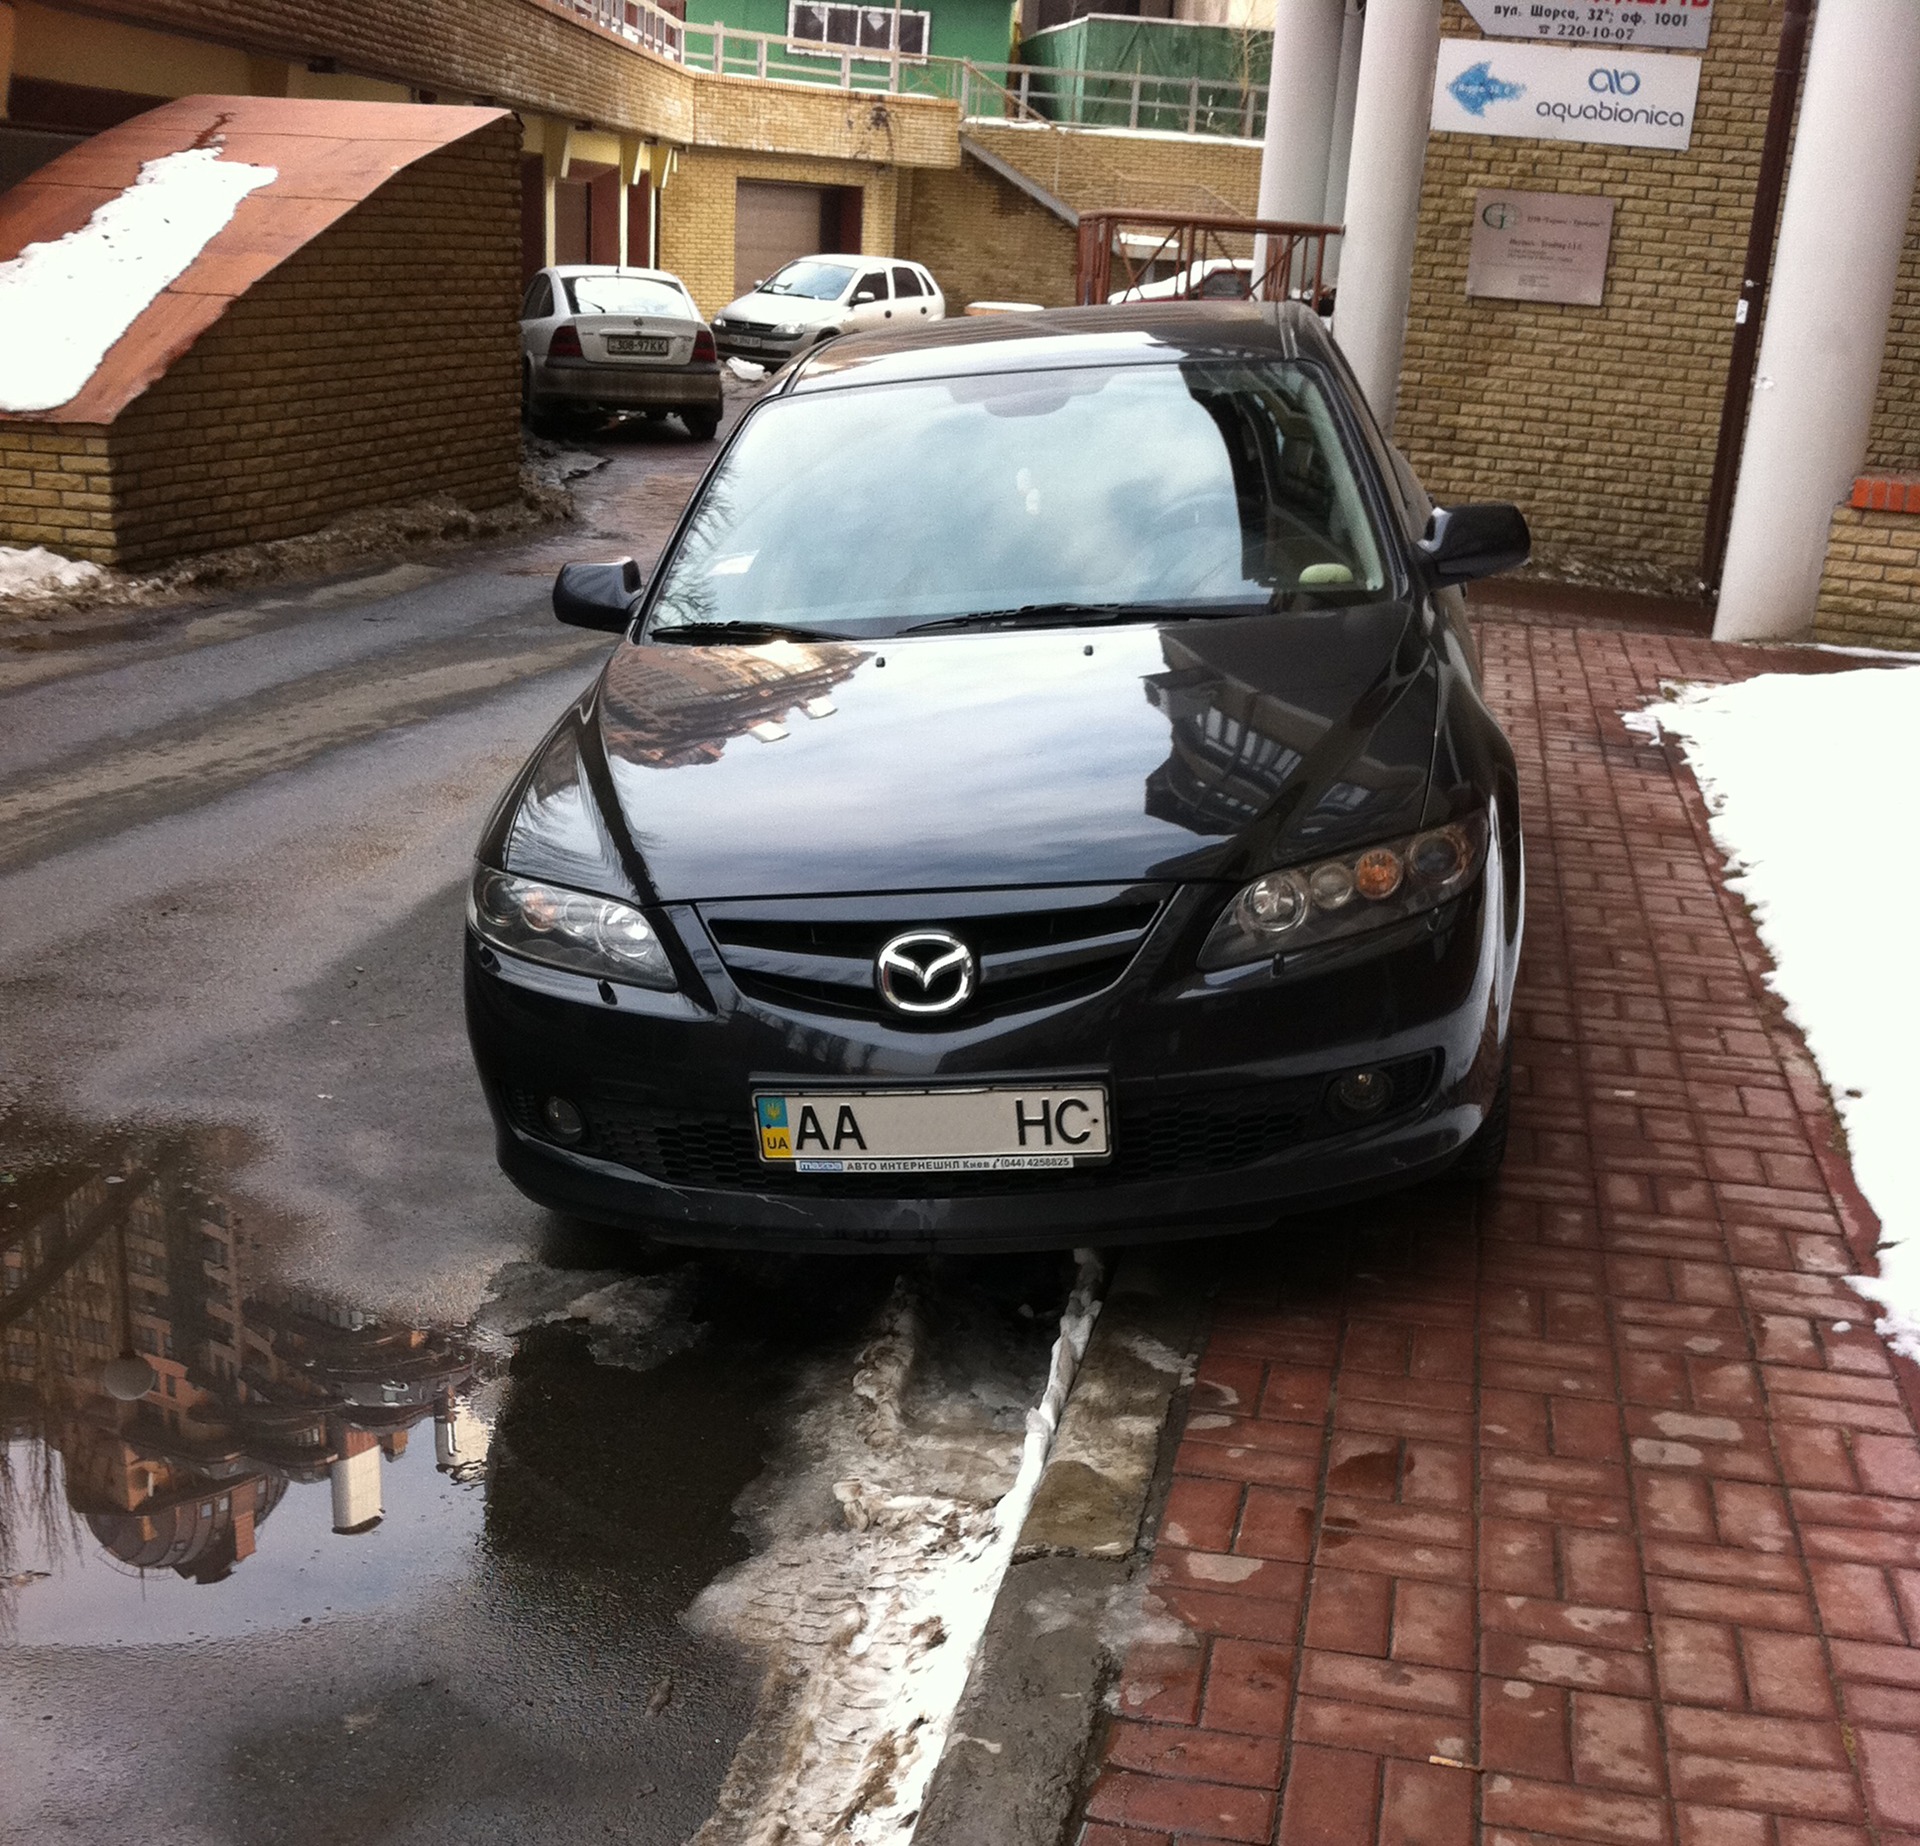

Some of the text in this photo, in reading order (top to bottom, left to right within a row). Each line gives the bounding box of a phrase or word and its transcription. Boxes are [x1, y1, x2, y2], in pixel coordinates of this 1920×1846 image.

[1494, 5, 1521, 17] вул.
[1655, 13, 1688, 27] 1001
[1558, 24, 1634, 40] 220-10-07
[1536, 101, 1685, 127] aquabionica
[767, 1098, 1091, 1150] UA AA HC
[847, 1162, 877, 1171] АВТО
[962, 1160, 990, 1169] Киев
[1001, 1158, 1025, 1168] (044)
